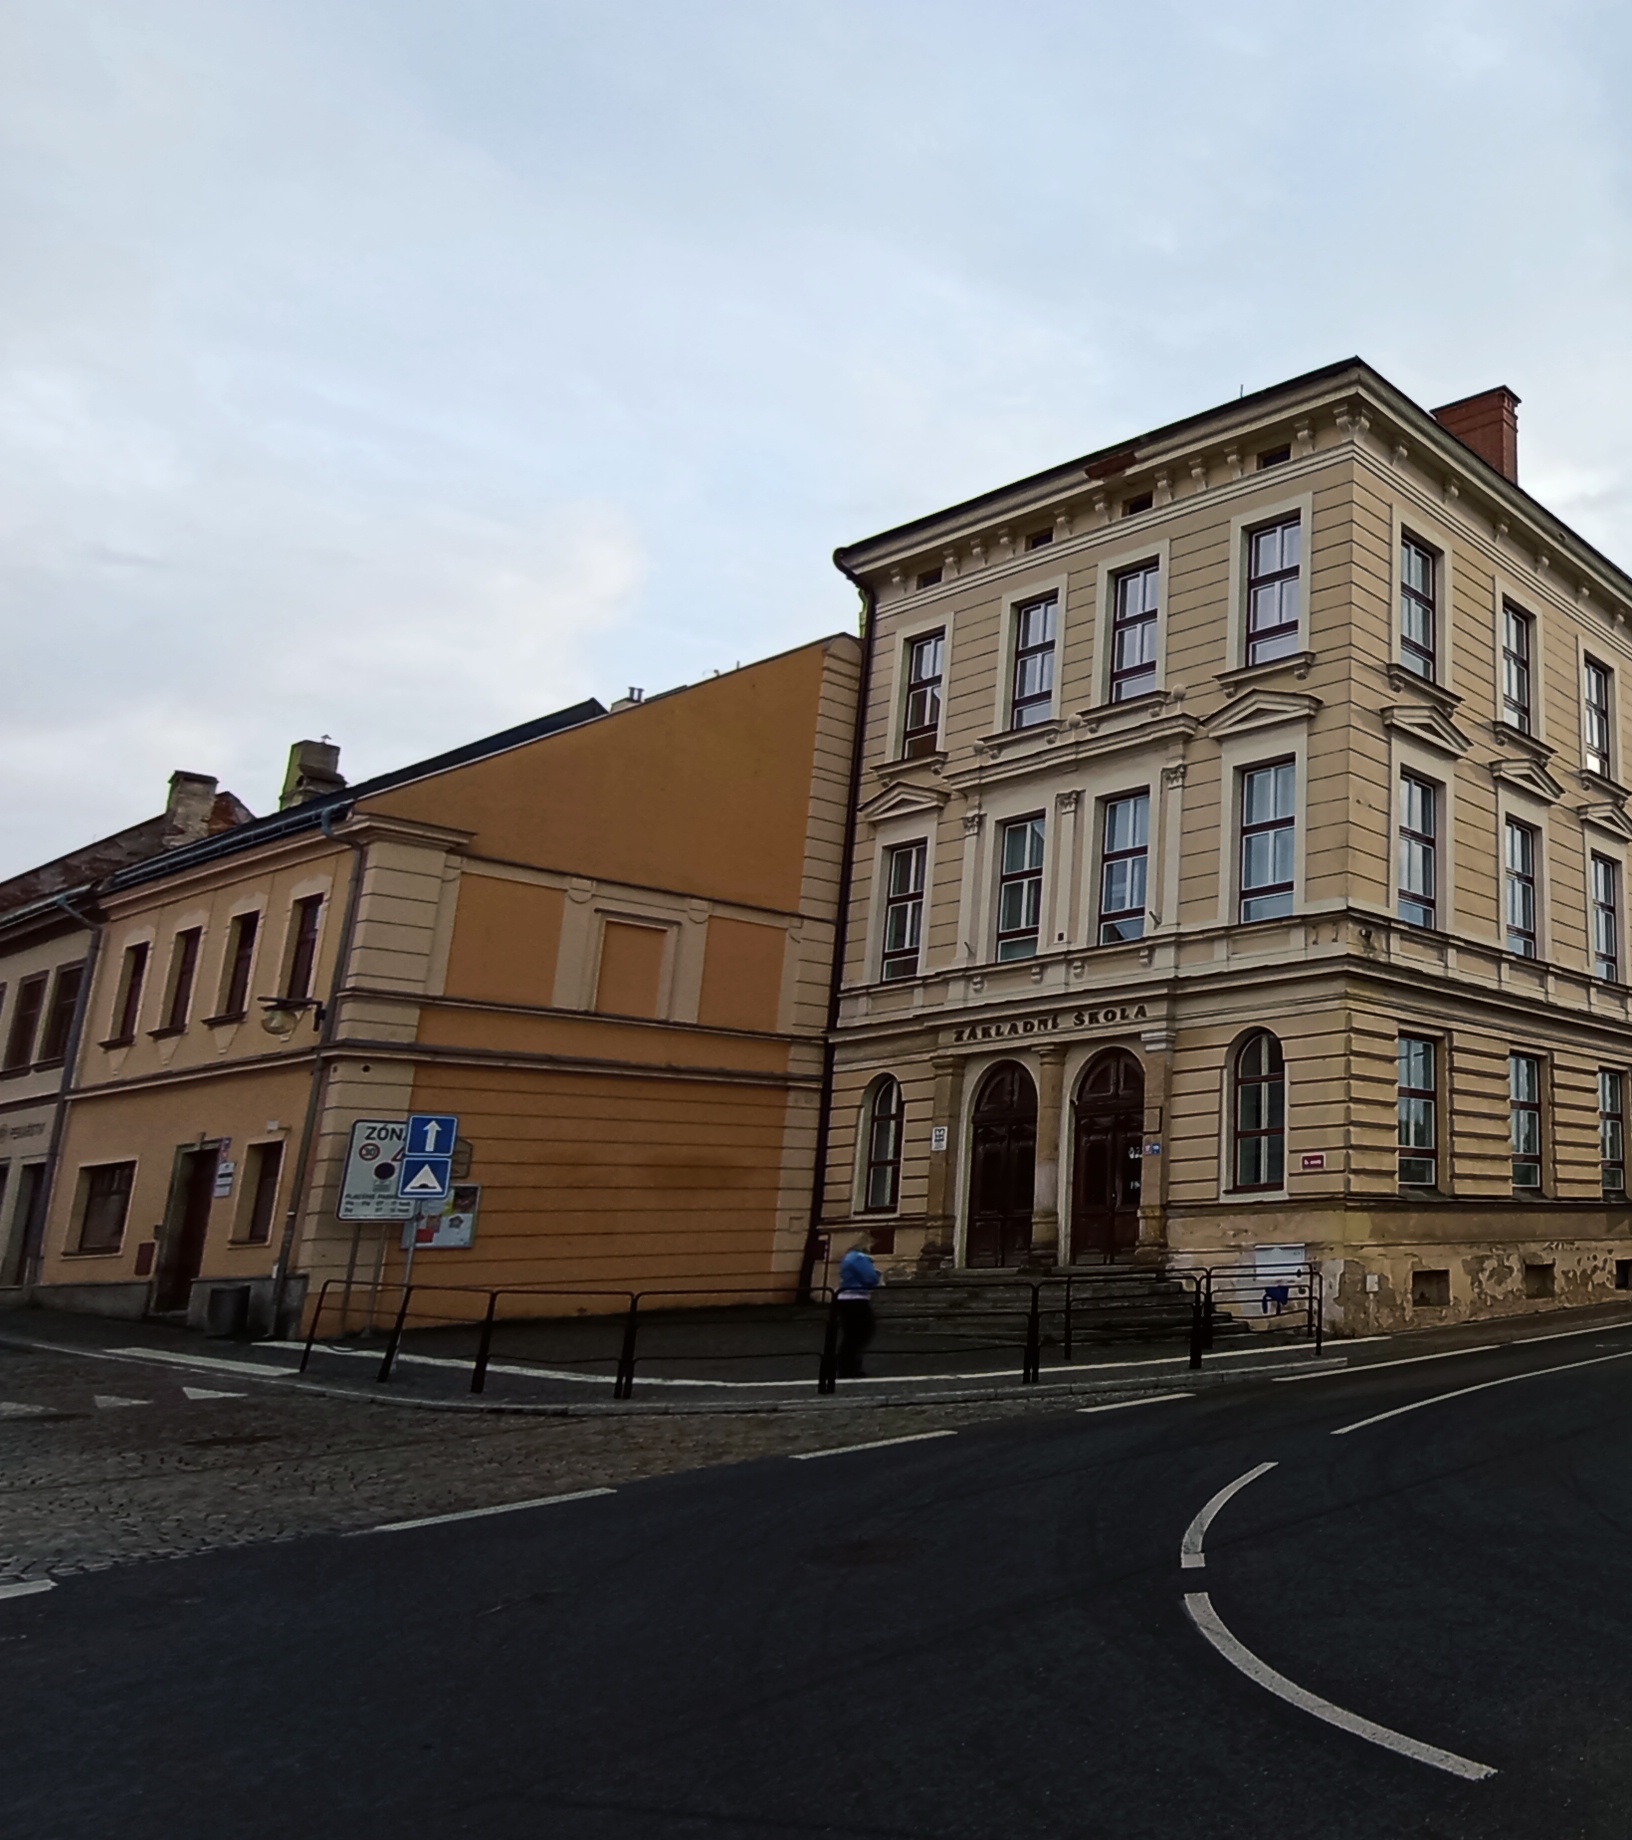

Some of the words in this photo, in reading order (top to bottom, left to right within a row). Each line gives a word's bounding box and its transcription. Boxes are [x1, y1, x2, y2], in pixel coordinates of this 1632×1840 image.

[953, 1014, 1060, 1042] ZÁKLADNÍ
[1073, 1004, 1148, 1027] ŠKOLA
[364, 1124, 406, 1140] ZÓN
